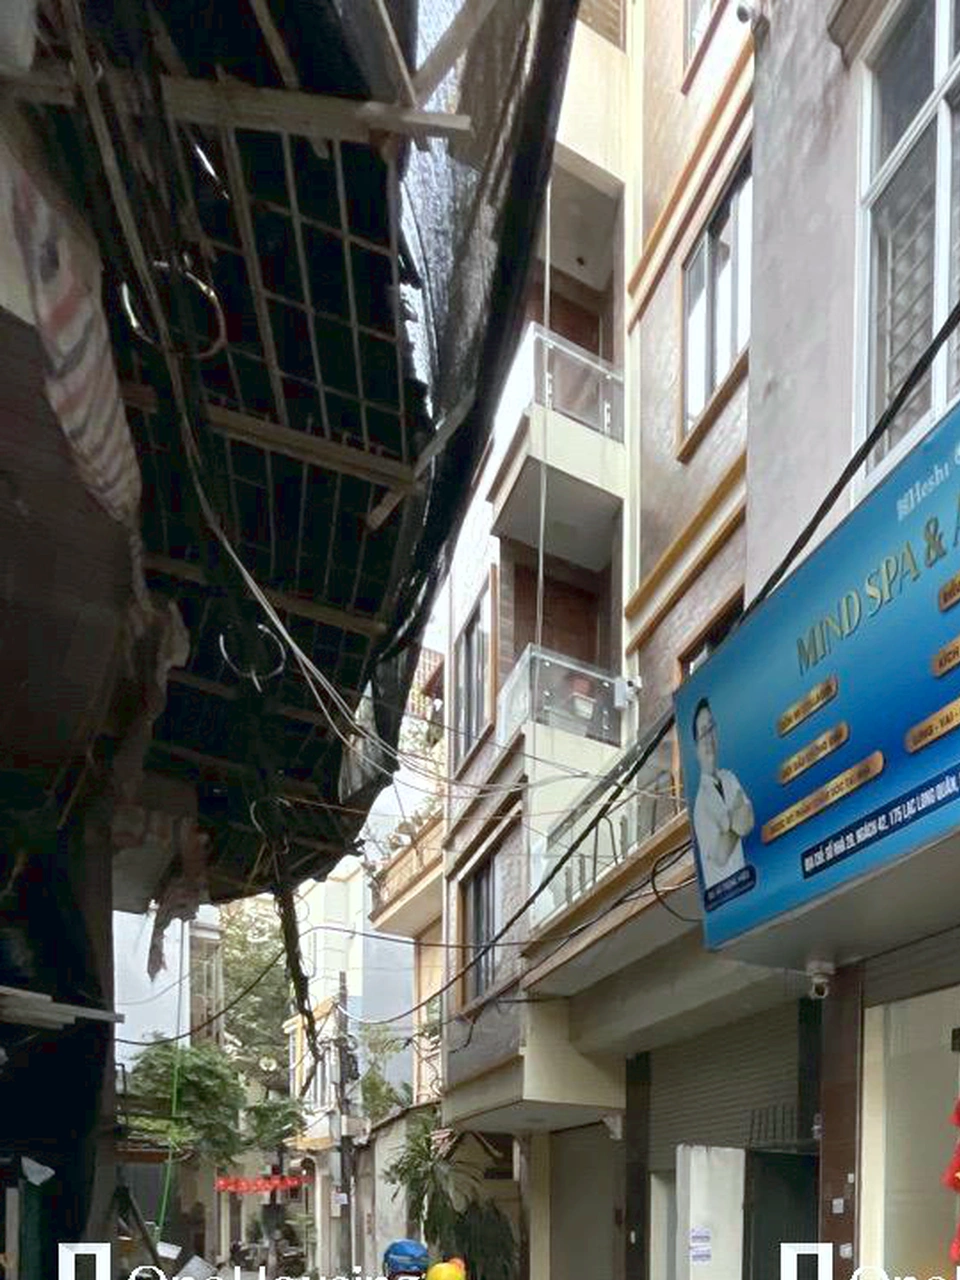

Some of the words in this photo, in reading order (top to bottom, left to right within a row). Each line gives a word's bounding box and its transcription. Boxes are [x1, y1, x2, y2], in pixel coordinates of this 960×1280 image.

[797, 588, 861, 676] MIND
[866, 541, 920, 620] SPA
[924, 516, 947, 569] &
[940, 709, 955, 727] VAI
